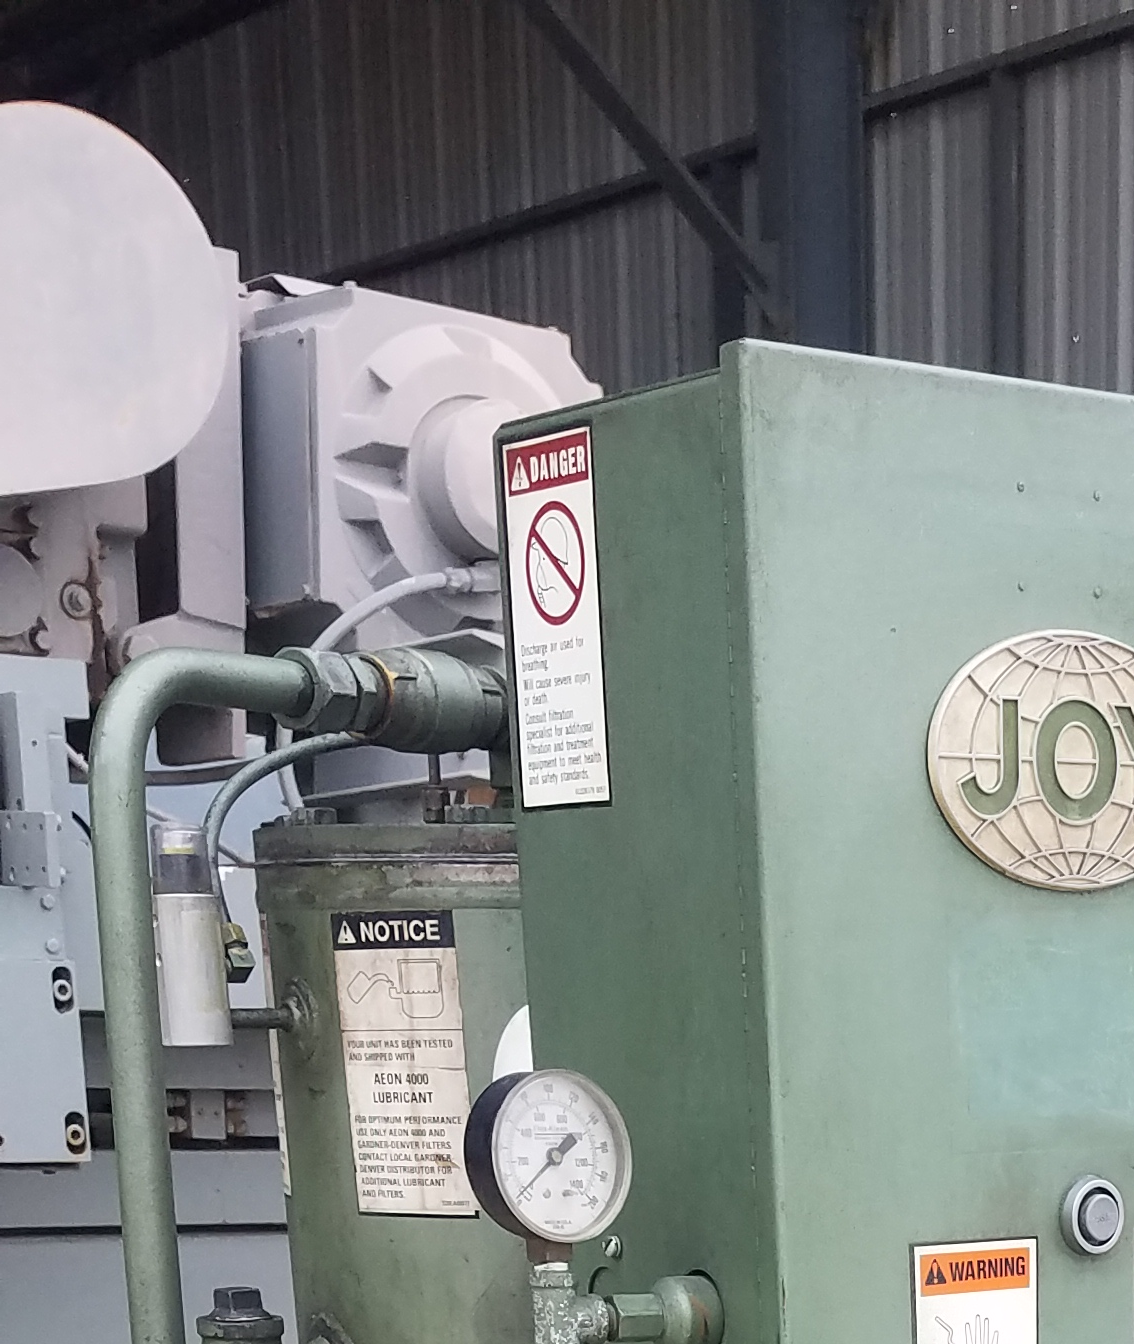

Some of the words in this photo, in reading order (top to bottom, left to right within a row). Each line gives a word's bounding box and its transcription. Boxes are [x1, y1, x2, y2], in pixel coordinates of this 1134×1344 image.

[529, 445, 586, 483] DANGER
[359, 920, 440, 942] NOTICE
[347, 1040, 365, 1049] YOUR
[366, 1040, 382, 1048] UNIT
[384, 1040, 399, 1048] HAS
[401, 1039, 421, 1048] BEEN
[424, 1039, 453, 1048] TESTED
[349, 1053, 362, 1061] AND
[364, 1053, 393, 1061] SHIPPED
[394, 1053, 415, 1061] WITH
[374, 1073, 402, 1085] AEON
[405, 1073, 429, 1085] 4000
[373, 1092, 433, 1103] LUBRICANT
[356, 1128, 367, 1136] USE
[370, 1128, 387, 1136] ONLY
[389, 1129, 409, 1137] AEON
[411, 1129, 426, 1137] 4000
[429, 1129, 446, 1137] AND
[358, 1153, 388, 1161] CONTACT
[360, 1165, 385, 1173] DENVER
[386, 1165, 435, 1174] DISTRIBUTOR
[437, 1166, 452, 1174] FOR
[361, 1177, 401, 1186] ADDITIONAL
[403, 1178, 445, 1187] LUBRICANT
[362, 1190, 375, 1198] AND
[949, 1256, 1025, 1282] WARNING
